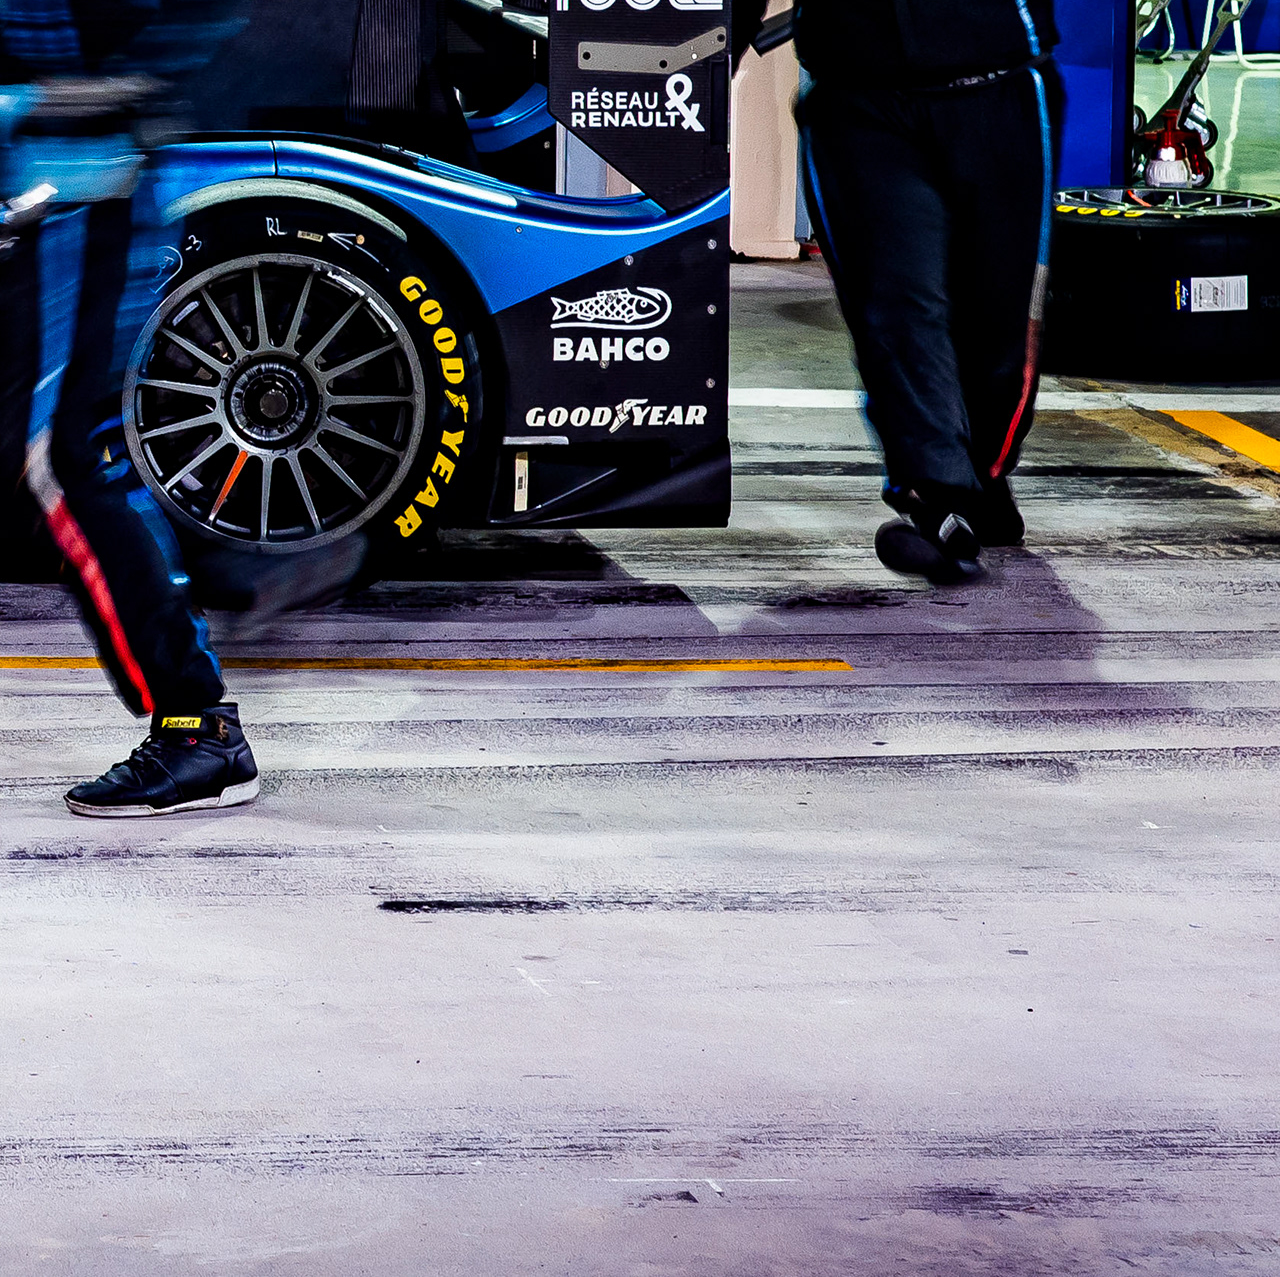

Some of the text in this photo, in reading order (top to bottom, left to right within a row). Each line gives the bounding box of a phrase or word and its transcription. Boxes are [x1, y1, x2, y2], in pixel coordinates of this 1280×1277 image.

[571, 87, 659, 110] RÉSEAU
[571, 112, 680, 127] RENAULT
[265, 217, 288, 237] RL
[552, 337, 671, 362] BAHCO
[525, 398, 708, 434] GOODYEAR
